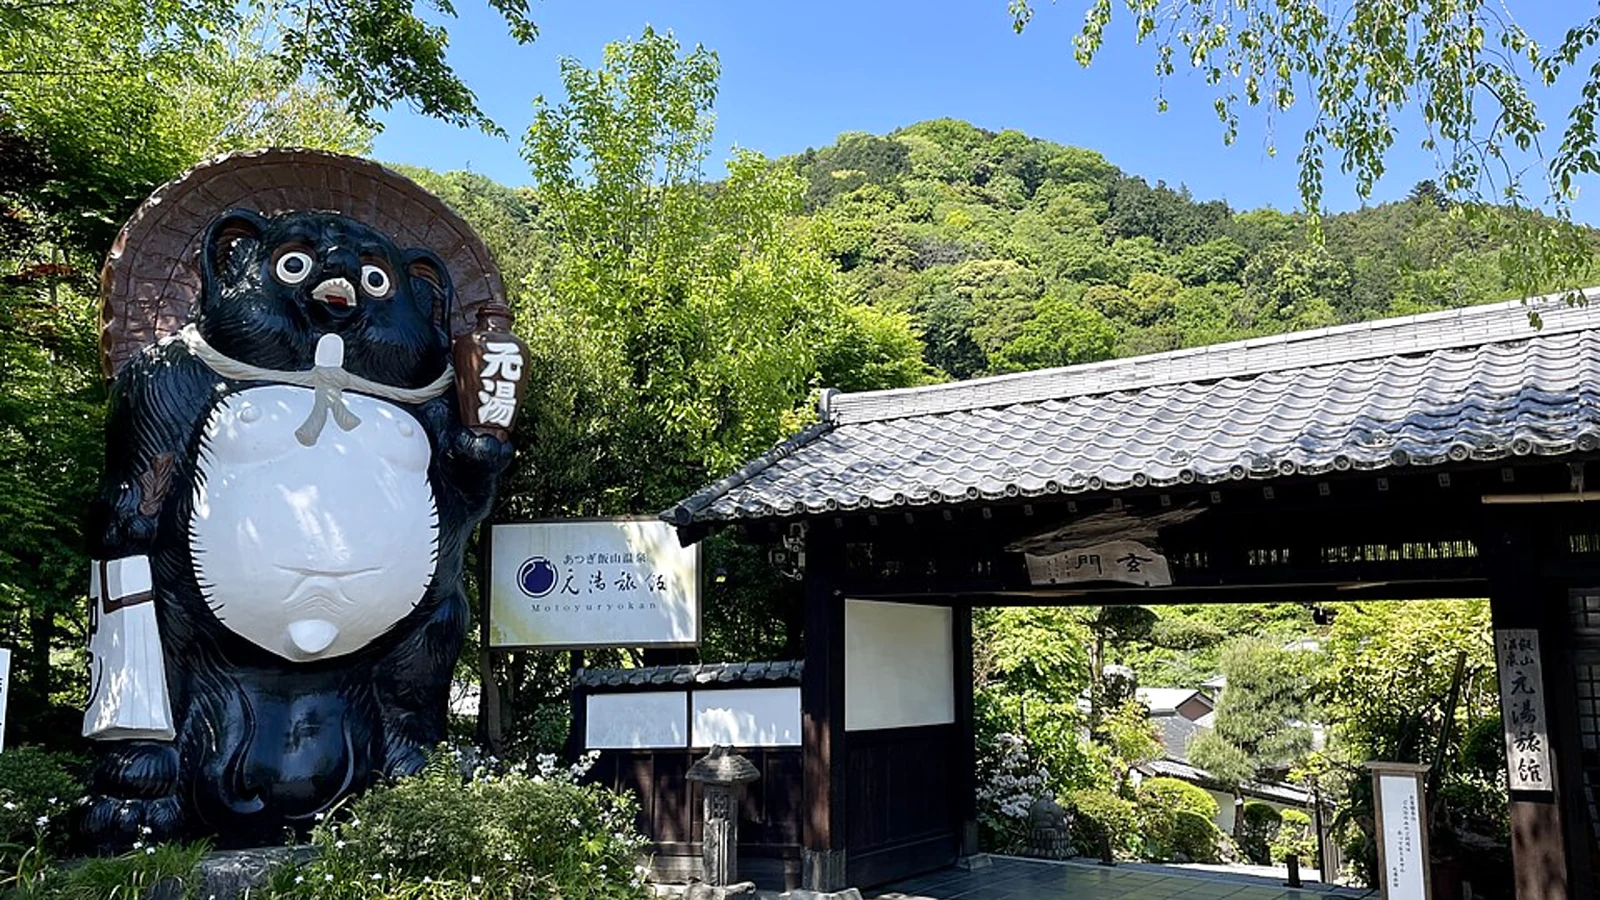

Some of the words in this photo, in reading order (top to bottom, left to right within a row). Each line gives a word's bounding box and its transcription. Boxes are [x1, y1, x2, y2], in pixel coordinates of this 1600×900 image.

[478, 342, 524, 428] 元湯
[562, 552, 647, 566] あつぎ飯山温泉
[531, 601, 657, 612] Motoyuryokan
